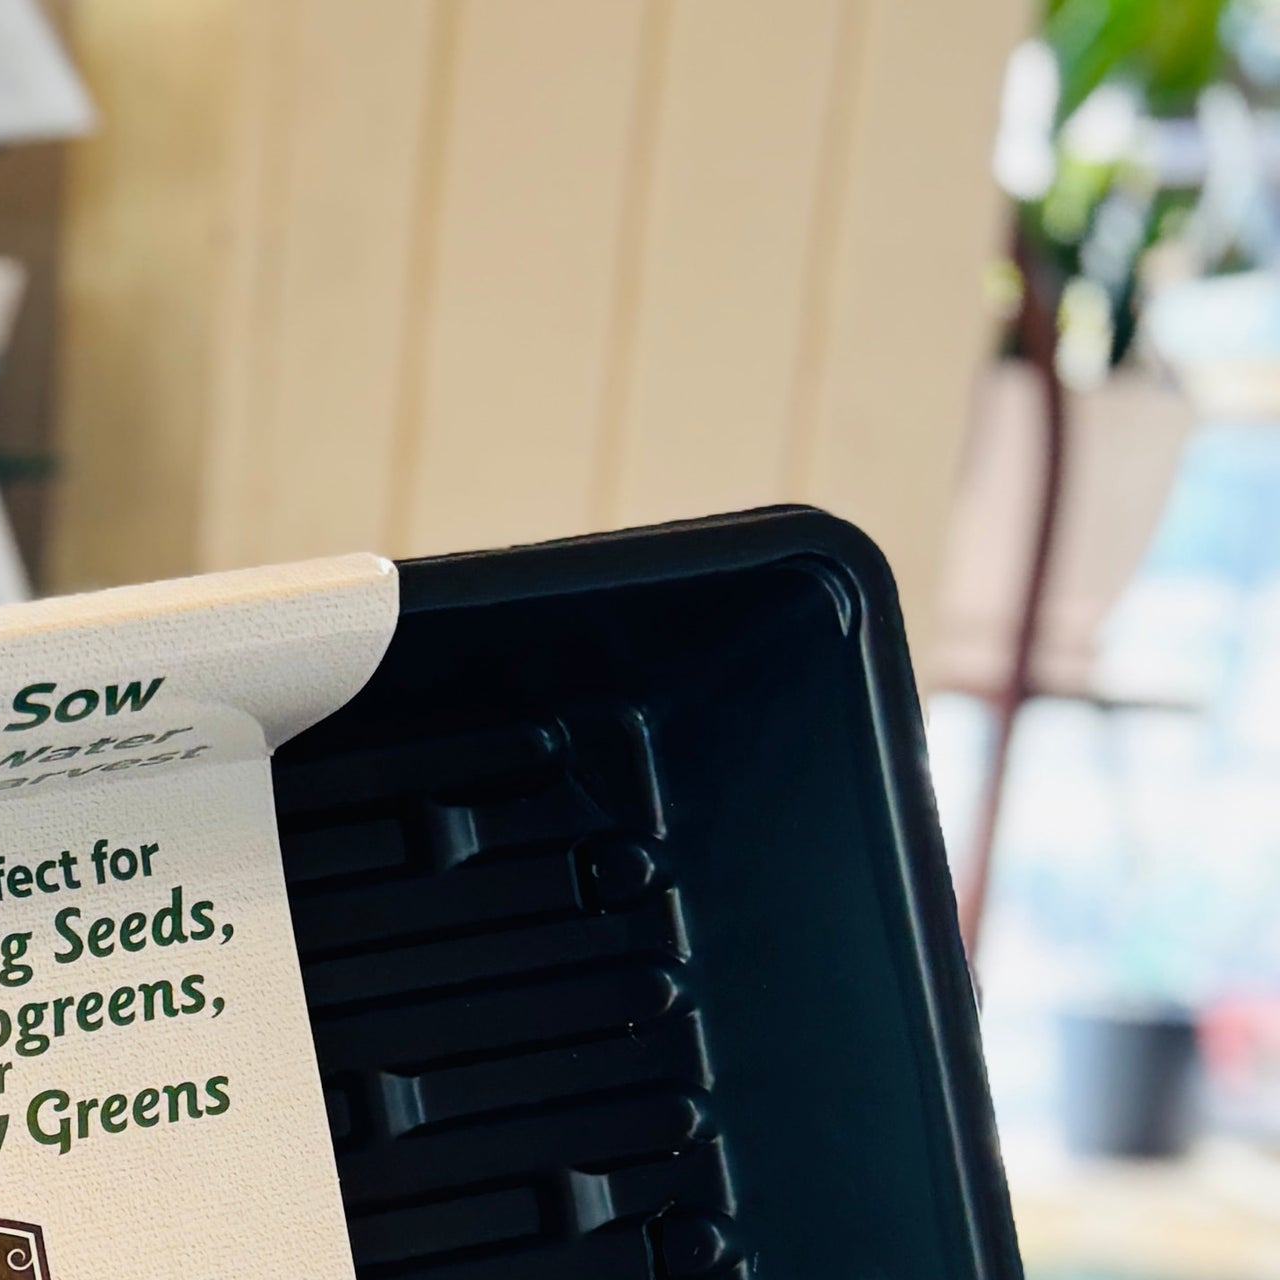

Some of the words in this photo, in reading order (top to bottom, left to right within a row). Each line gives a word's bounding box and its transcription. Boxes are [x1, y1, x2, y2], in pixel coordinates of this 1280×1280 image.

[3, 676, 167, 733] Sow
[91, 839, 160, 885] for
[54, 885, 235, 965] Seeds,
[26, 1075, 231, 1155] Greens
